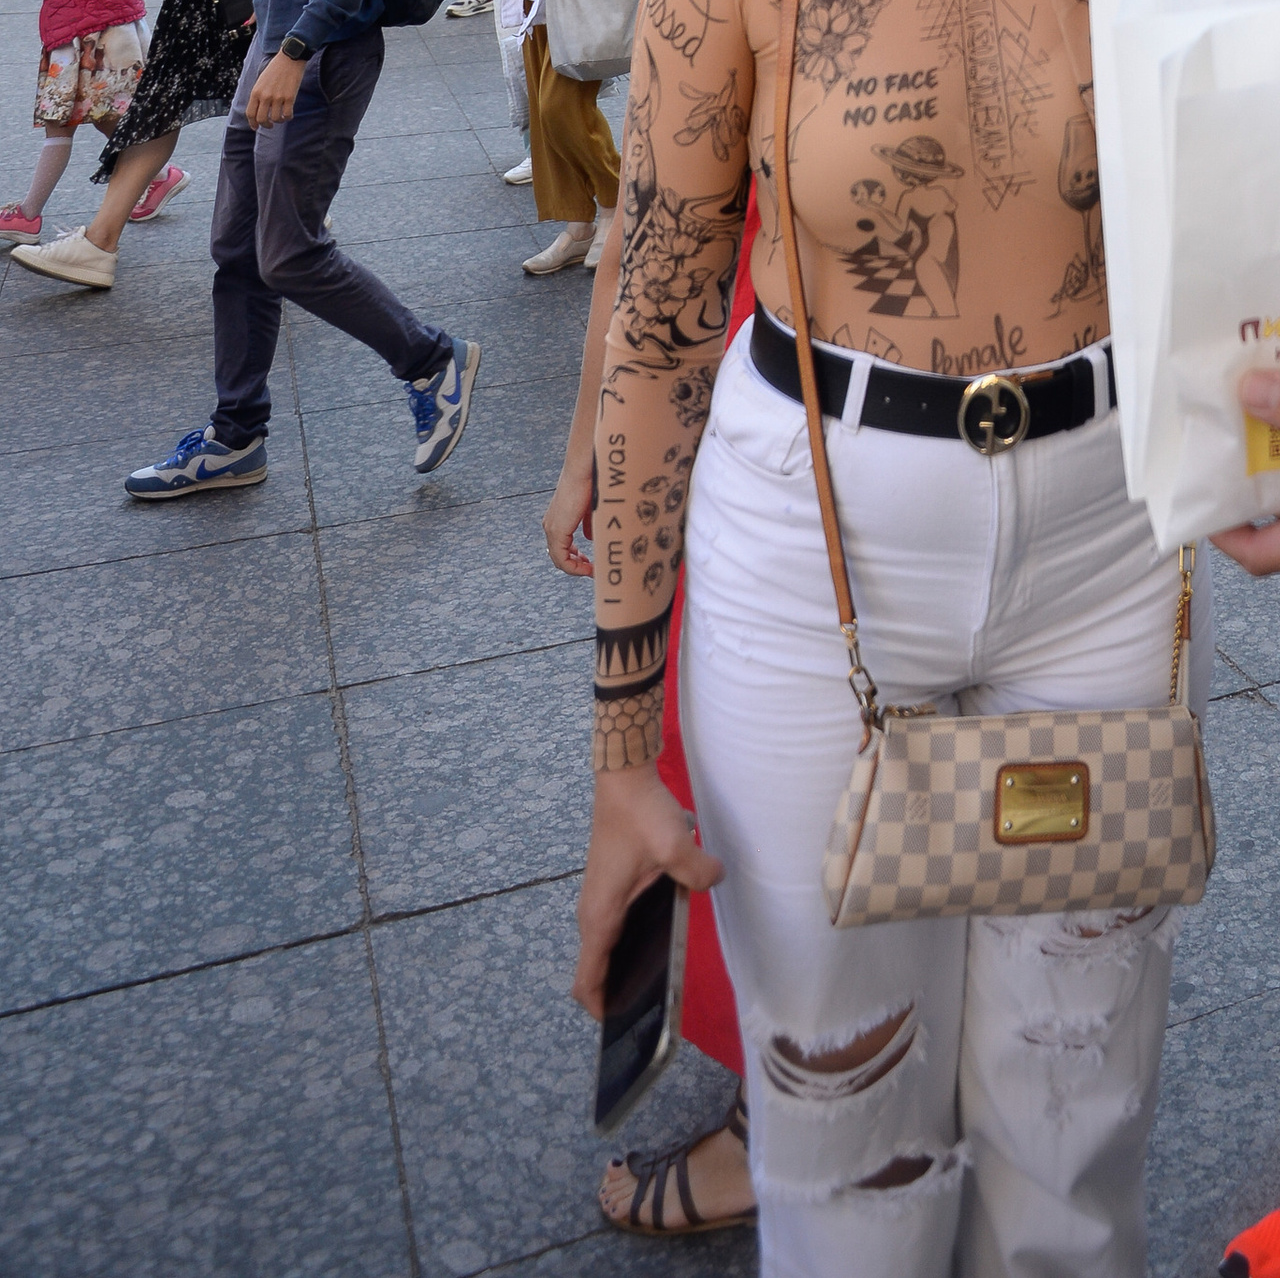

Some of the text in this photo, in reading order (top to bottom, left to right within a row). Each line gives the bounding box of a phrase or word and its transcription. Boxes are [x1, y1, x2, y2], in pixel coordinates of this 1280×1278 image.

[846, 67, 938, 97] NO FACE
[843, 97, 938, 128] NO CASE
[608, 433, 626, 487] was
[608, 541, 622, 586] am
